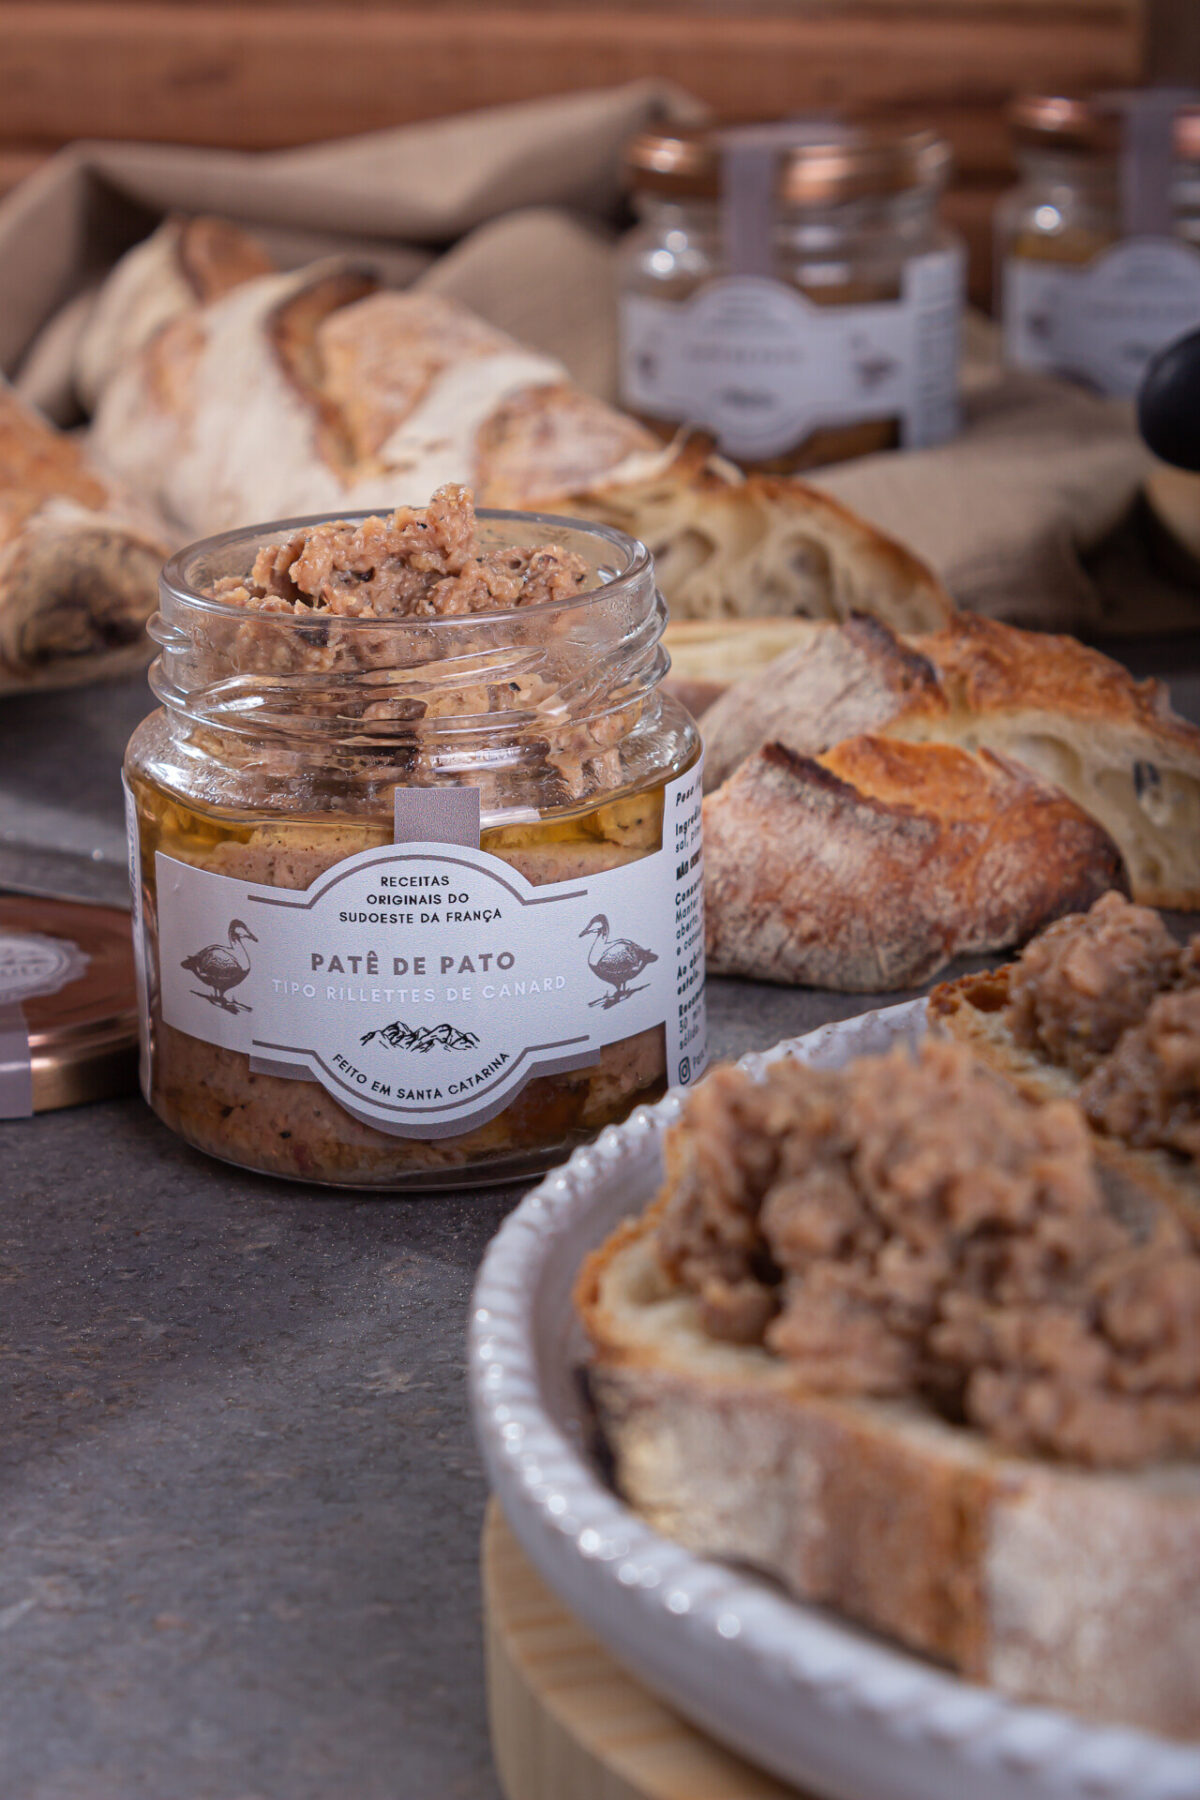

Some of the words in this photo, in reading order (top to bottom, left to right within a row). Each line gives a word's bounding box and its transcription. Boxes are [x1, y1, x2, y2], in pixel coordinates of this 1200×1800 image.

[380, 875, 450, 887] RECEITAS
[366, 894, 442, 906] ORIGINAIS
[448, 893, 469, 904] DO
[339, 911, 414, 924] SUDOESTE
[420, 912, 440, 924] DA
[446, 907, 502, 923] FRANÇA
[311, 950, 379, 975] PATÊ
[393, 957, 426, 975] DE
[440, 951, 516, 974] PATO
[272, 978, 316, 998] TIPO
[326, 985, 436, 1003] RILLETTES
[446, 987, 472, 1001] DE
[482, 975, 566, 999] CANARD
[332, 1053, 368, 1084] FEITO
[370, 1080, 391, 1097] EM
[396, 1087, 443, 1101] SANTA
[447, 1052, 511, 1096] CATARINA
